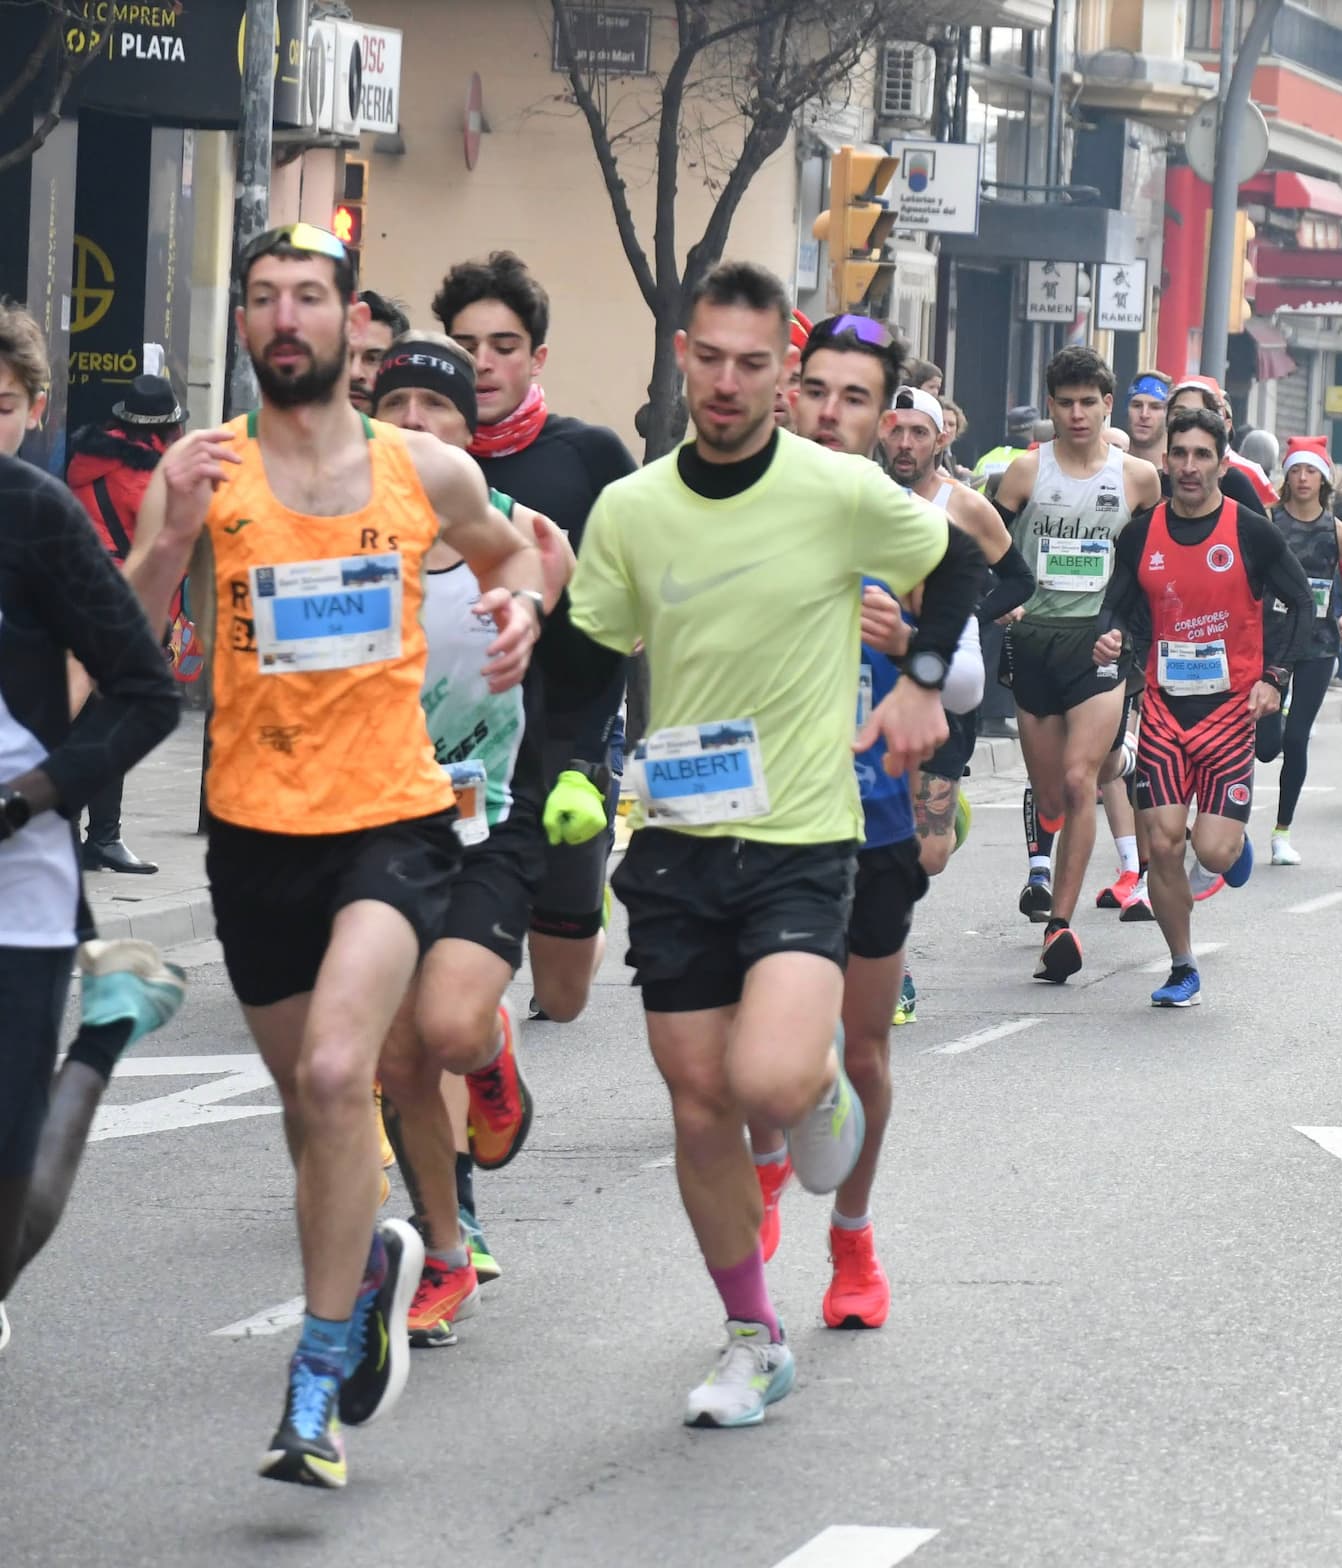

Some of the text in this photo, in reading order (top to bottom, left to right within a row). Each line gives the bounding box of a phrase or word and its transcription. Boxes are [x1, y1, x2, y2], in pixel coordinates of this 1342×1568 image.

[121, 32, 186, 62] PLATA
[1030, 303, 1073, 314] RAMEN
[1101, 311, 1142, 323] RAMEN
[1049, 556, 1101, 567] ALBERT
[303, 594, 365, 621] IVAN
[1187, 661, 1221, 671] CARLOS
[651, 751, 743, 782] ALBERT
